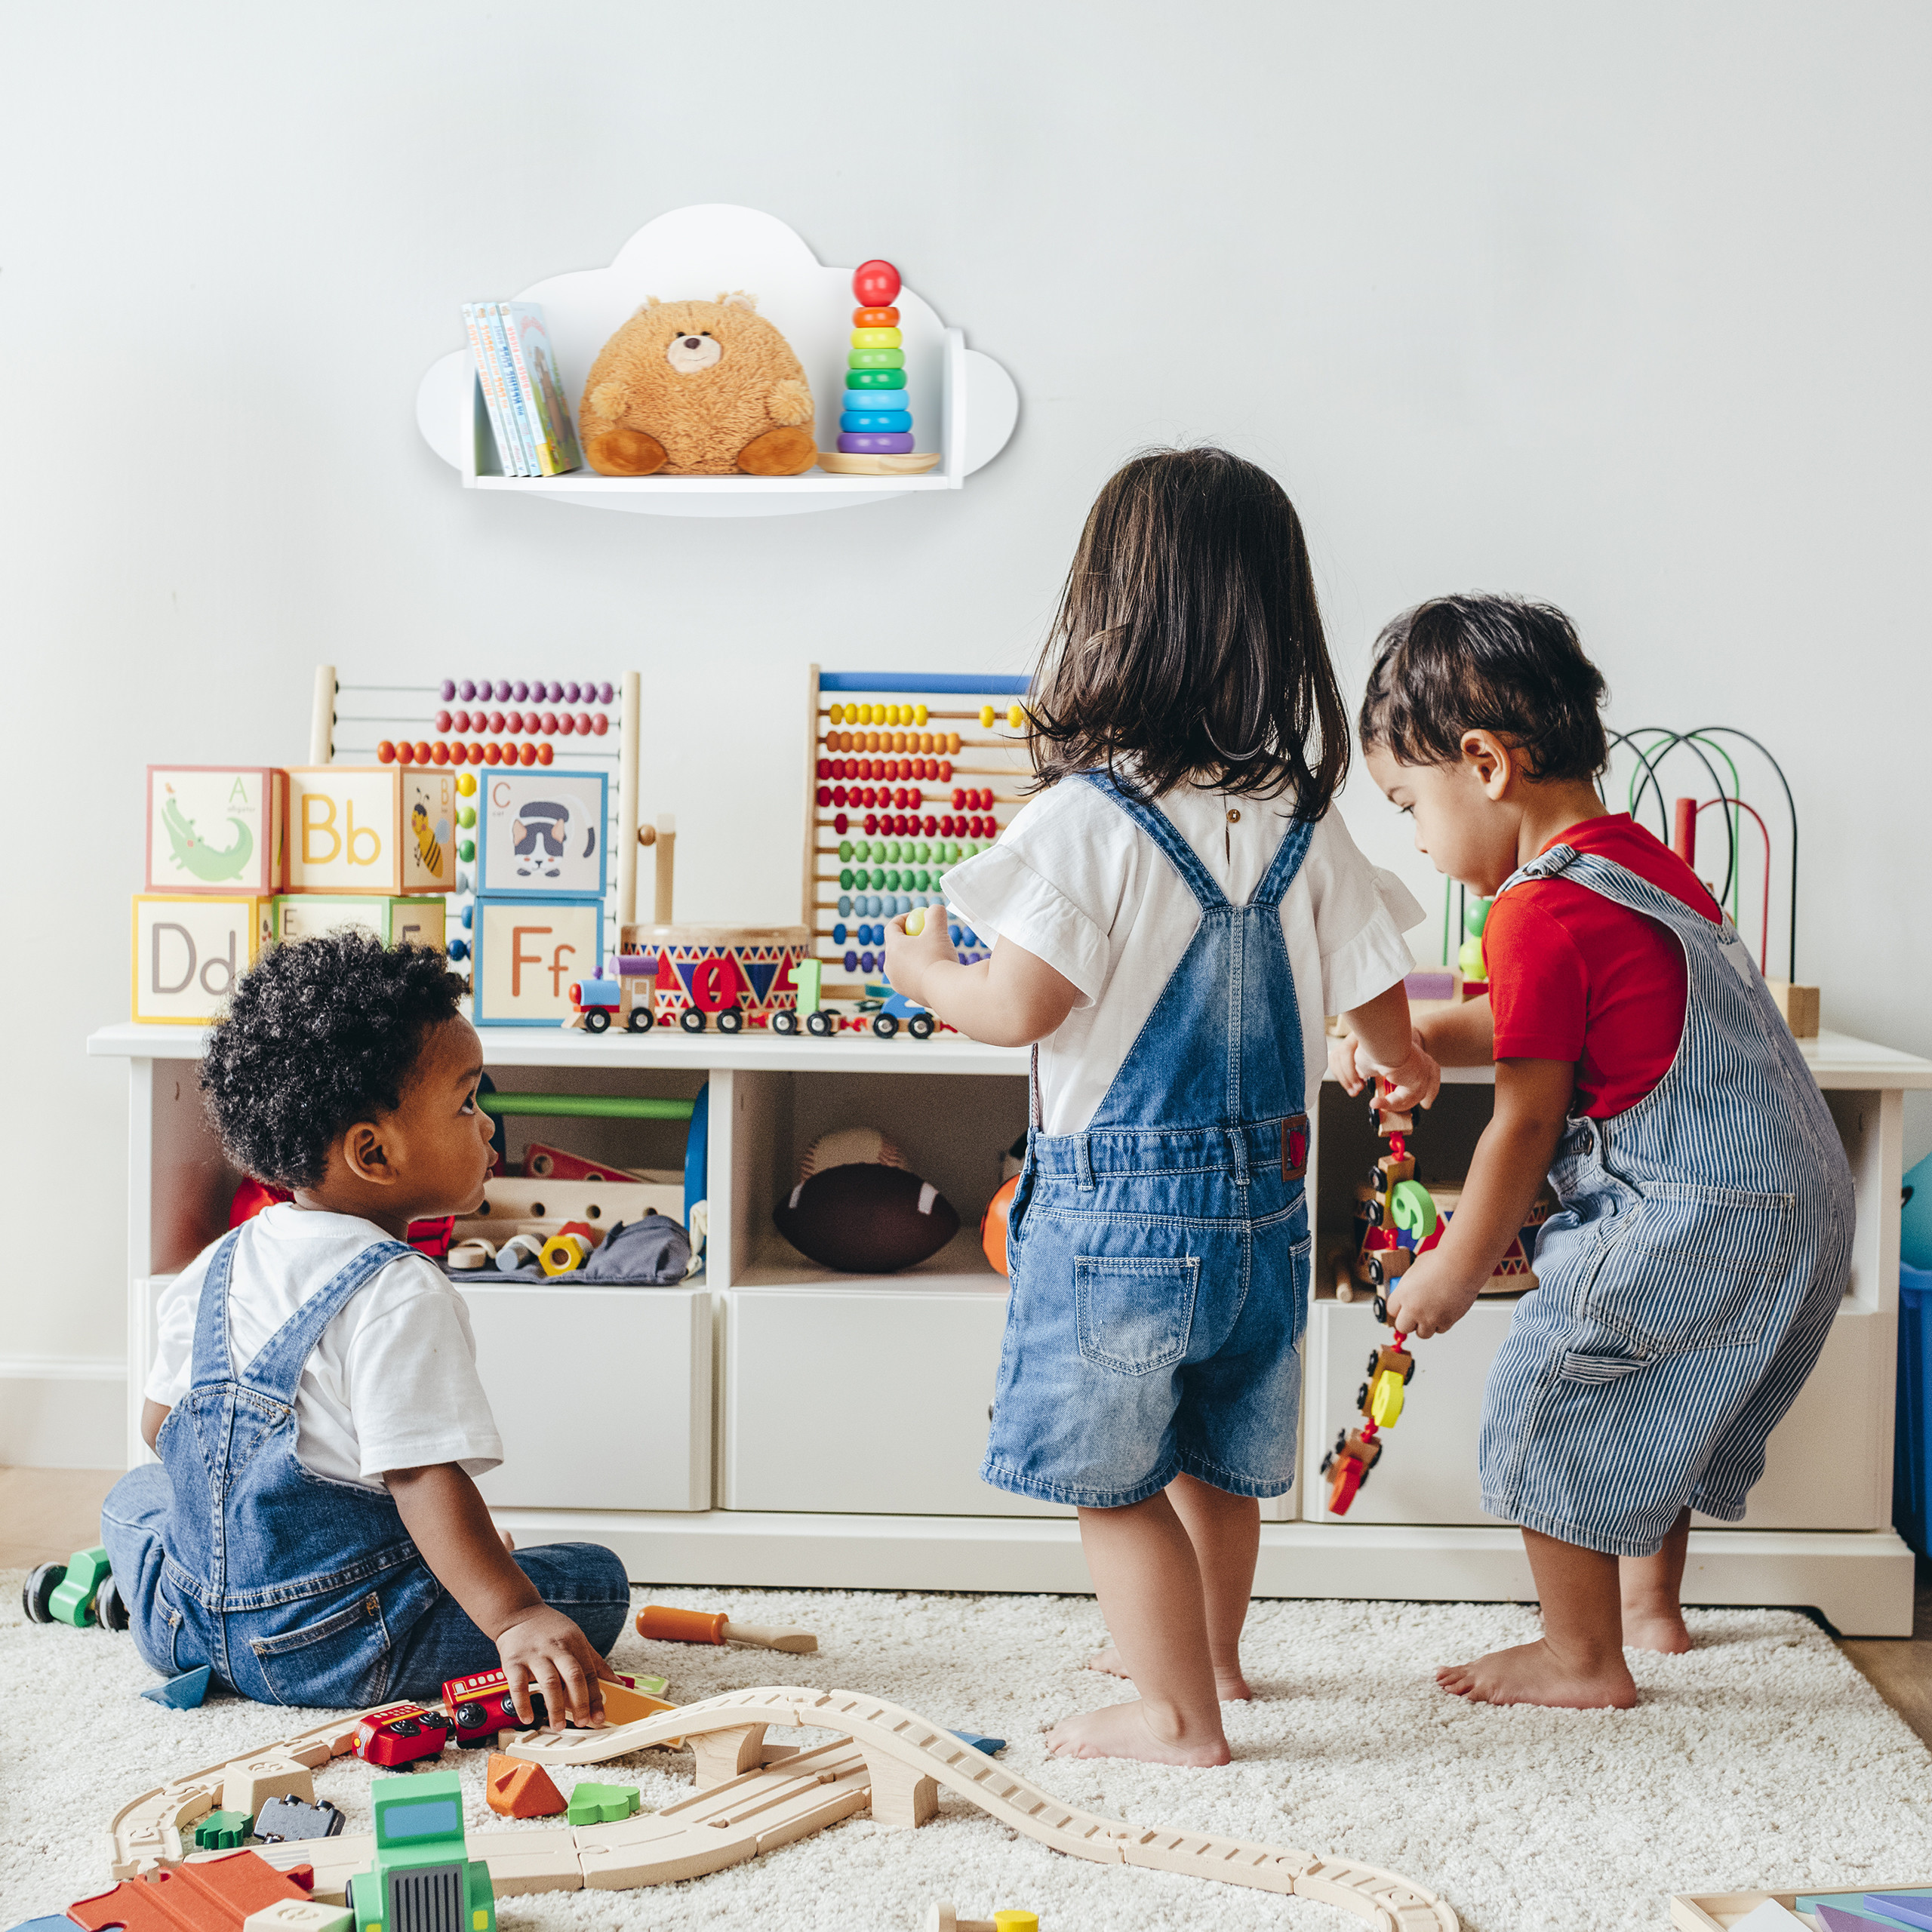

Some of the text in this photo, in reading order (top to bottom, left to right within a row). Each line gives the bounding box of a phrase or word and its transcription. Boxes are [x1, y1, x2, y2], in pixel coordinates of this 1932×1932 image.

[479, 325, 495, 352] BEULE
[497, 346, 512, 367] EULE
[478, 371, 494, 395] MAUS
[493, 377, 507, 397] EULE
[504, 371, 522, 404] KLEINE
[229, 776, 248, 803] A
[440, 778, 449, 806] B
[492, 782, 512, 808] C
[301, 793, 382, 866] Bb
[283, 909, 297, 936] E
[152, 923, 236, 995] Dd
[512, 926, 577, 997] Ff
[788, 958, 823, 1015] 1
